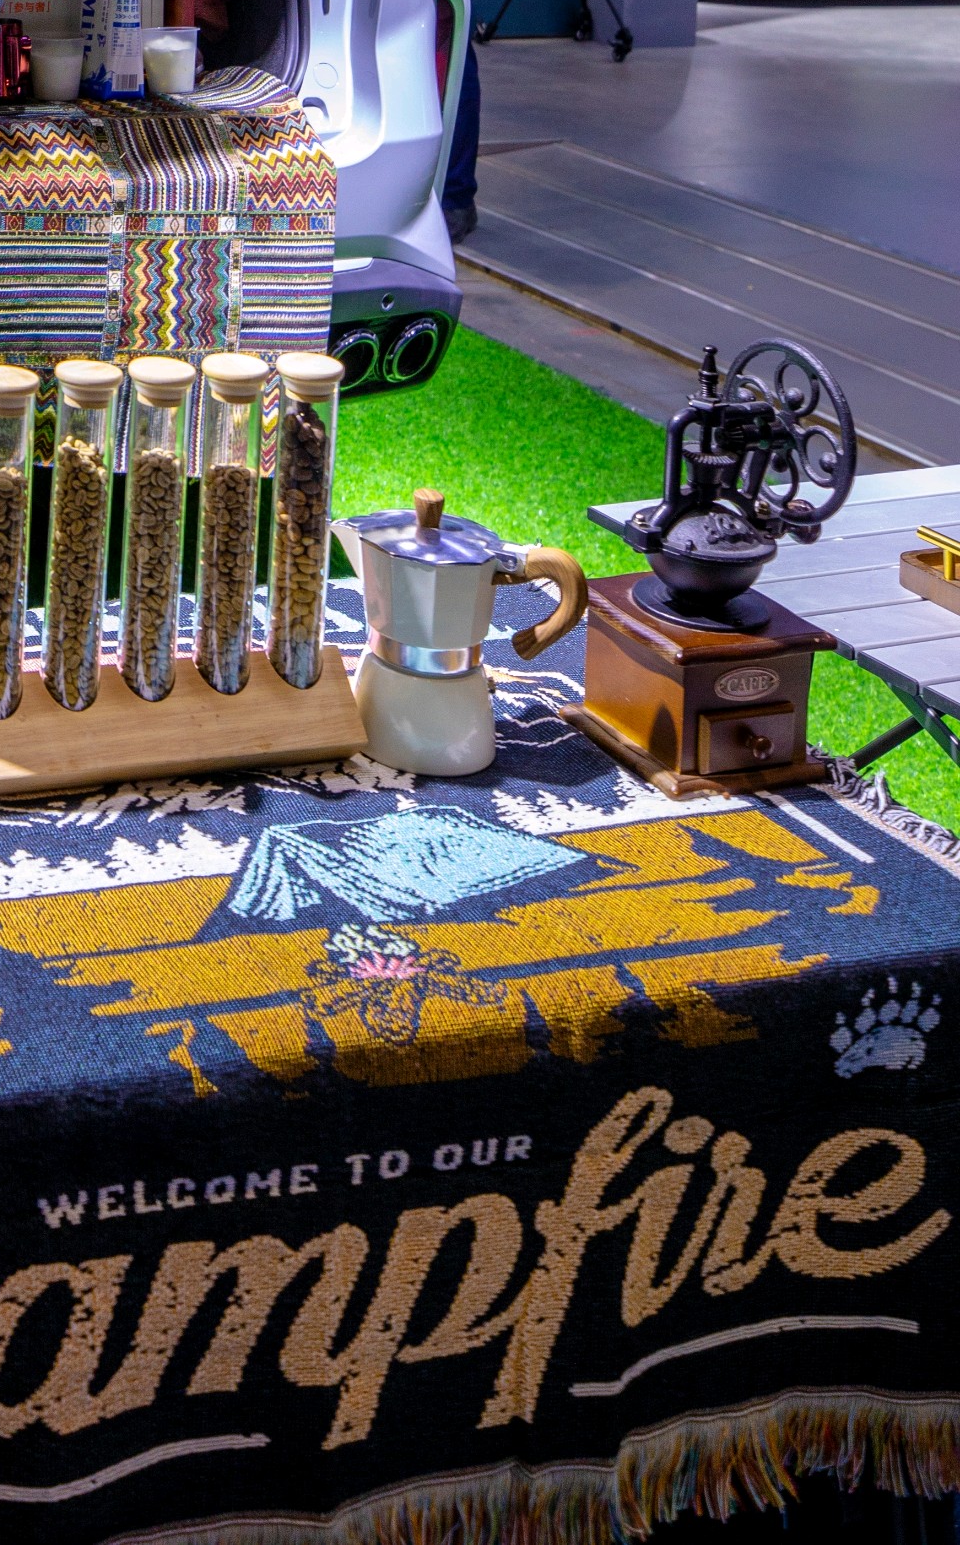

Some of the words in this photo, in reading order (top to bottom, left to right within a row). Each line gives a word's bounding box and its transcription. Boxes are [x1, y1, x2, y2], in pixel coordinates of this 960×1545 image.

[726, 675, 769, 694] CAFE
[37, 1163, 320, 1229] WELCOME
[345, 1150, 410, 1186] TO
[433, 1134, 534, 1172] OUR
